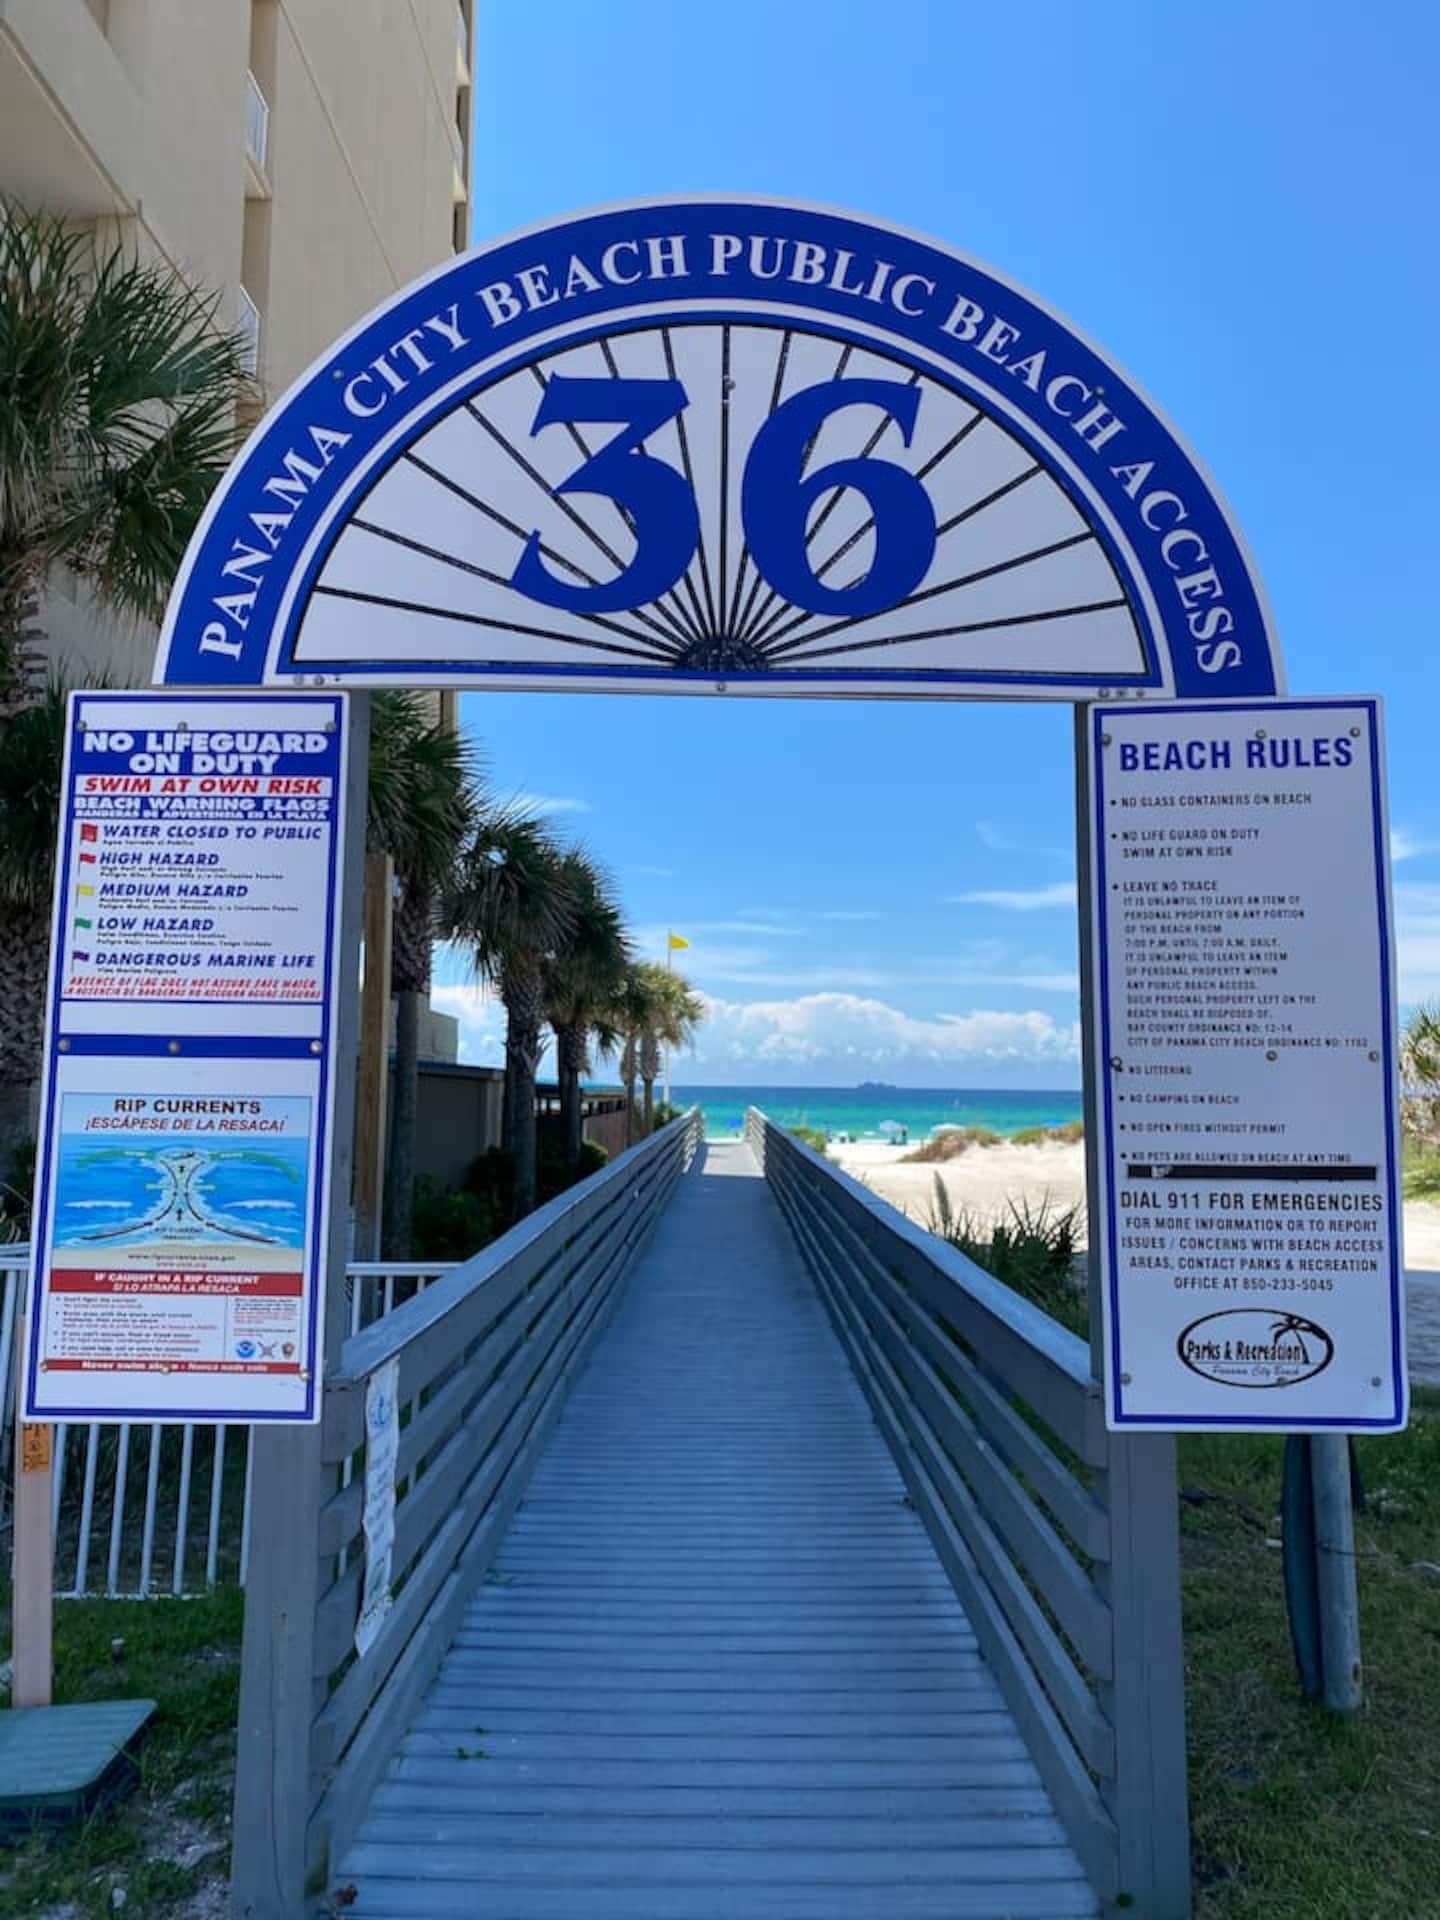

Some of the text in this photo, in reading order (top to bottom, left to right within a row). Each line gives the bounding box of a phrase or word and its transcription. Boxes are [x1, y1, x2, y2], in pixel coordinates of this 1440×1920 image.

[199, 234, 1243, 673] PANAMA CITY BEACH PUBLIC BEACH ACCESS
[511, 371, 937, 616] 36
[83, 733, 327, 753] NO LIFEGUARD
[1119, 738, 1352, 770] BEACH RULES
[129, 754, 279, 773] ON DUTY
[84, 778, 322, 793] SWIM AT OWN RISK
[73, 798, 328, 811] BEACH WARNING FLAGS
[1121, 794, 1311, 808] NO GLASS CONTAINERS ON BEACH
[101, 826, 322, 839] WATER CLOSED TO PUBLIC
[1121, 829, 1259, 840] NO LIFE GUARD ON DUTY
[98, 853, 220, 864] HIGH HAZARD
[1123, 847, 1232, 858] SWIM AT OWN RISK
[99, 884, 249, 896] MEDIUM HAZARD
[1123, 881, 1216, 892] LEAVE NO TRACE
[96, 918, 214, 930] LOW HAZARD
[94, 953, 316, 967] DANGEROUS MARINE LIFE
[114, 1100, 261, 1114] RIP CURRENTS
[85, 1116, 284, 1132] ¡ESCÁPESE DE LA RESACA!
[1120, 1192, 1382, 1210] DIAL 911 FOR EMERGENCIES
[1125, 1218, 1376, 1232] FOR MORE INFORMATION OR TO REPORT
[1121, 1238, 1165, 1249] ISSUES
[1179, 1238, 1247, 1250] CONCERNS
[1251, 1239, 1284, 1250] WITH
[1287, 1240, 1330, 1251] BEACH
[1334, 1240, 1383, 1252] ACCESS
[1129, 1258, 1377, 1271] AREAS, CONTACT PARKS & RECREATION
[1174, 1279, 1332, 1290] OFFICE AT 850-233-5045
[1187, 1340, 1300, 1362] Parks & Recreation
